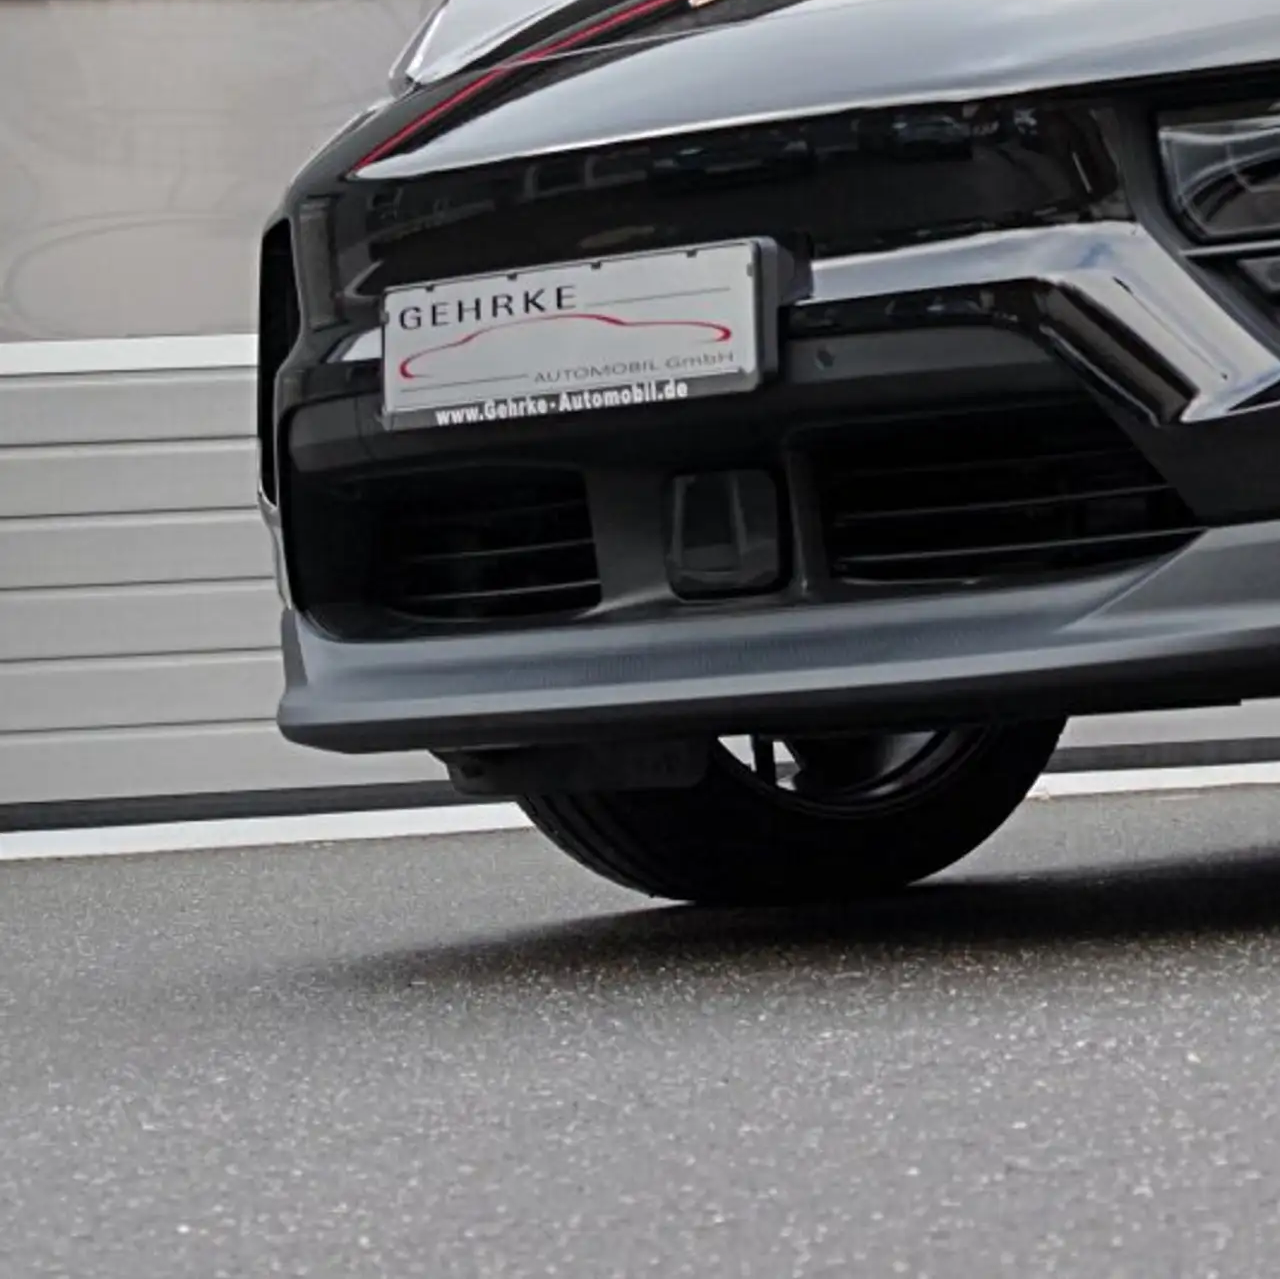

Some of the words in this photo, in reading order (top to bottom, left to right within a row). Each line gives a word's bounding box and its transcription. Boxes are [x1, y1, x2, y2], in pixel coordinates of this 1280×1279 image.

[399, 286, 579, 331] GEHRKE
[533, 358, 659, 384] AUTOMOBIL
[664, 350, 735, 370] GmbH
[434, 378, 690, 426] www.Gehrke-Automobil.de
